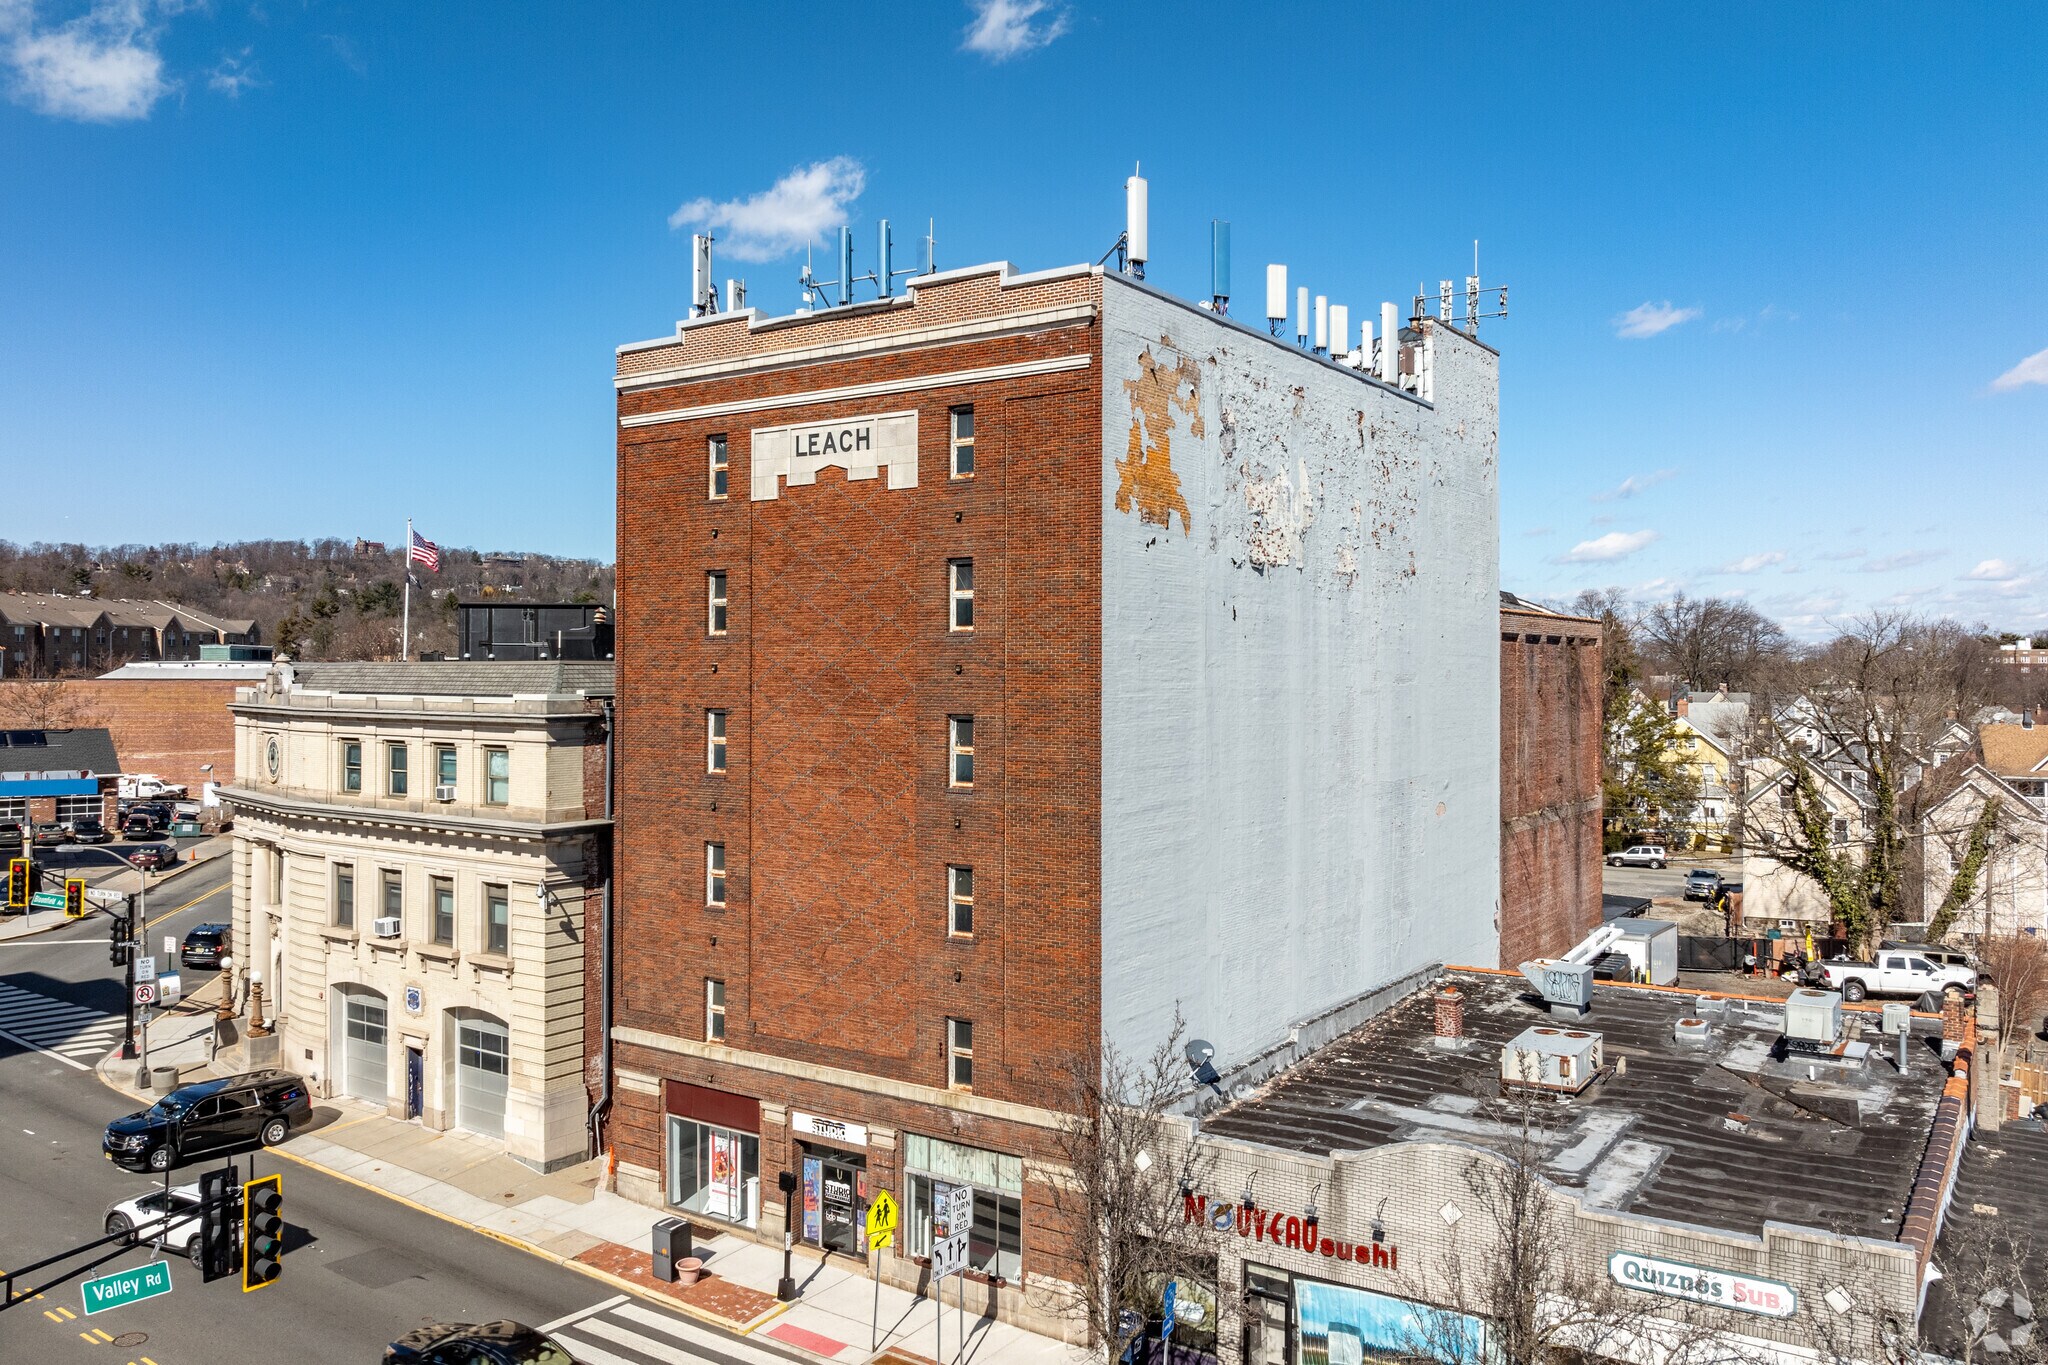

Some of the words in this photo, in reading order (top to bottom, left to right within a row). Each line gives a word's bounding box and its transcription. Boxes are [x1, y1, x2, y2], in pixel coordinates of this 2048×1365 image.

[795, 427, 870, 457] LEACH
[812, 1122, 846, 1136] STUDIO
[954, 1189, 968, 1203] NO
[952, 1200, 971, 1213] TURN
[956, 1212, 966, 1221] ON
[954, 1220, 969, 1232] RED
[1184, 1195, 1318, 1253] NOUVEAU
[1320, 1237, 1398, 1270] sushi
[934, 1268, 943, 1278] ONLY
[946, 1262, 956, 1272] ONLY
[92, 1277, 140, 1301] Valley
[145, 1272, 162, 1288] Rd
